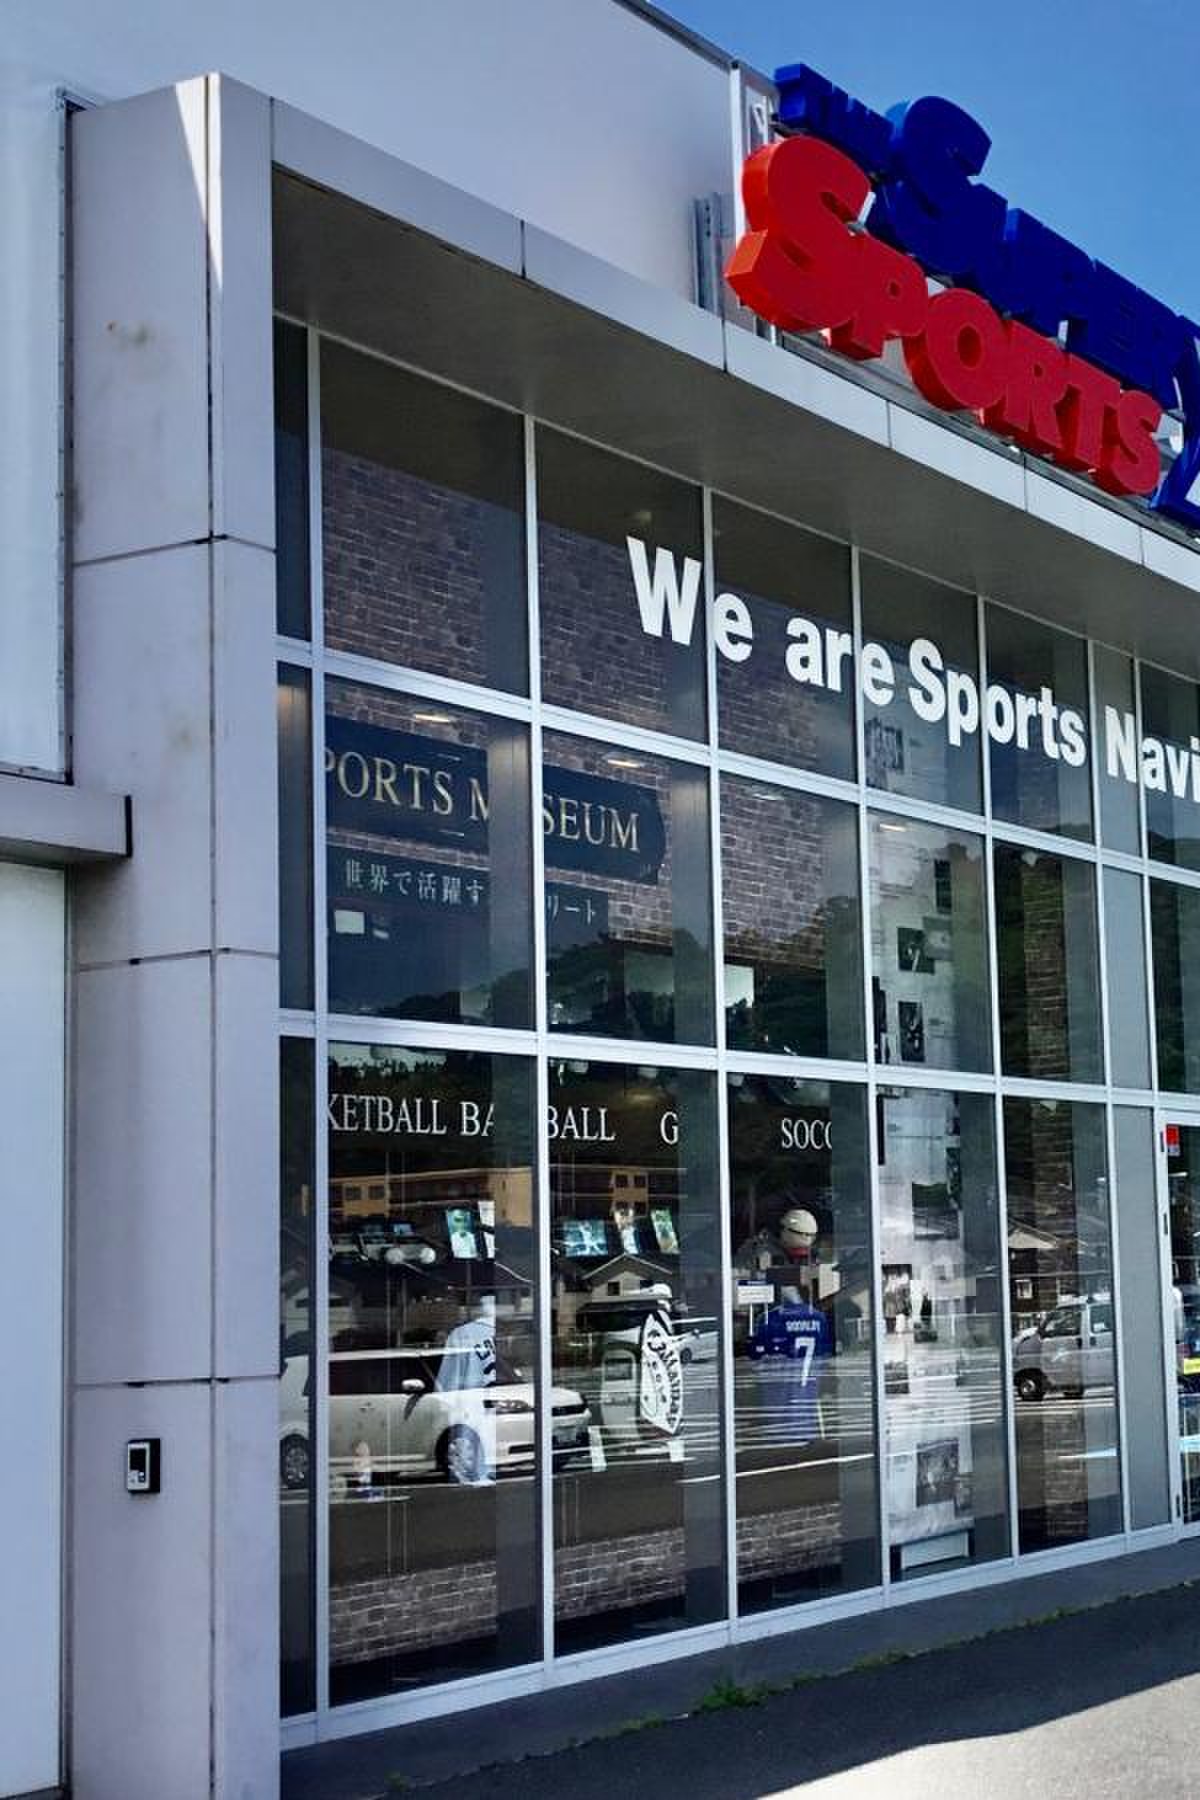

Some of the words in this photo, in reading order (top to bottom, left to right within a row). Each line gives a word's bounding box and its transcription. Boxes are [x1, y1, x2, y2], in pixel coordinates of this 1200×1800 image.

[728, 134, 1164, 497] SPORTS
[626, 537, 753, 663] We
[785, 617, 895, 706] are
[907, 638, 1087, 768] Sports
[795, 1337, 816, 1387] 7
